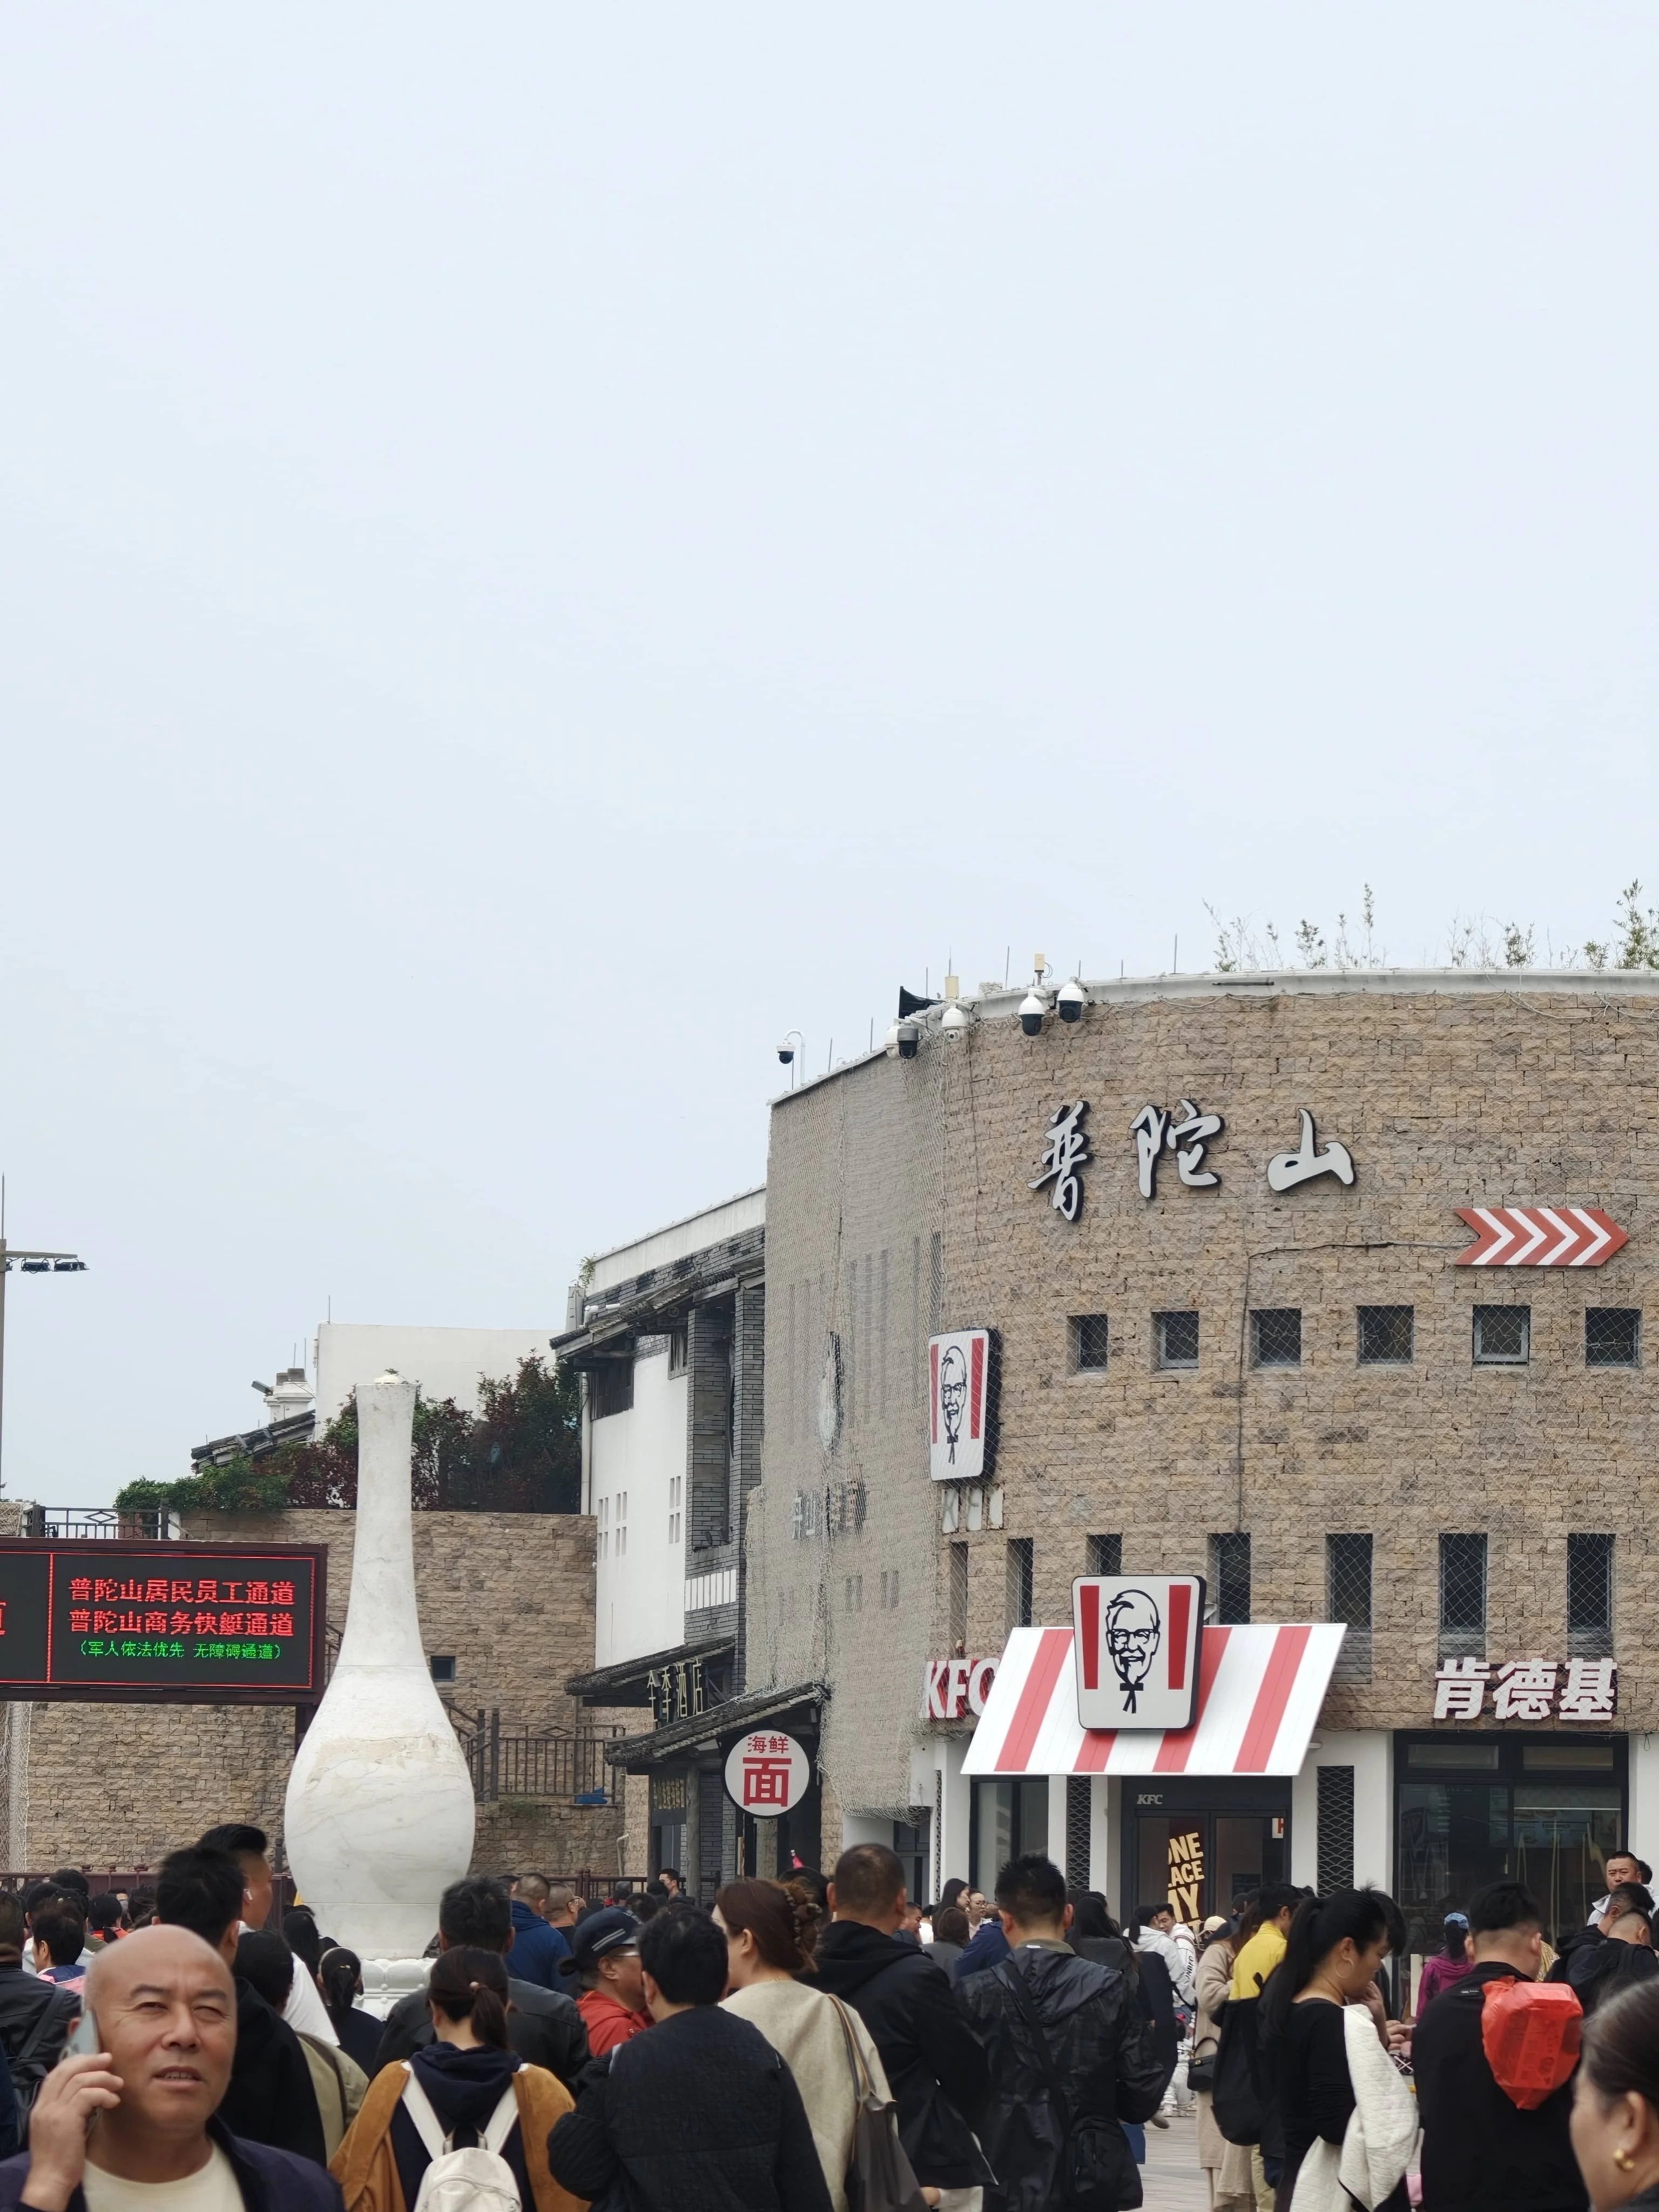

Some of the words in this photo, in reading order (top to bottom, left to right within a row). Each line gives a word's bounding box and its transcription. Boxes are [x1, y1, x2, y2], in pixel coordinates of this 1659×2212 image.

[1027, 1098, 1357, 1222] 普陀山
[67, 1577, 296, 1606] 普陀山居民员工通道
[68, 1609, 294, 1637] 普陀山商务快艇通道
[919, 1657, 1000, 1719] KFC
[1433, 1656, 1618, 1721] 肯德基
[747, 1735, 790, 1755] 海鲜
[742, 1757, 792, 1808] 面
[1136, 1793, 1164, 1805] KFC
[1168, 1860, 1205, 1888] ACE
